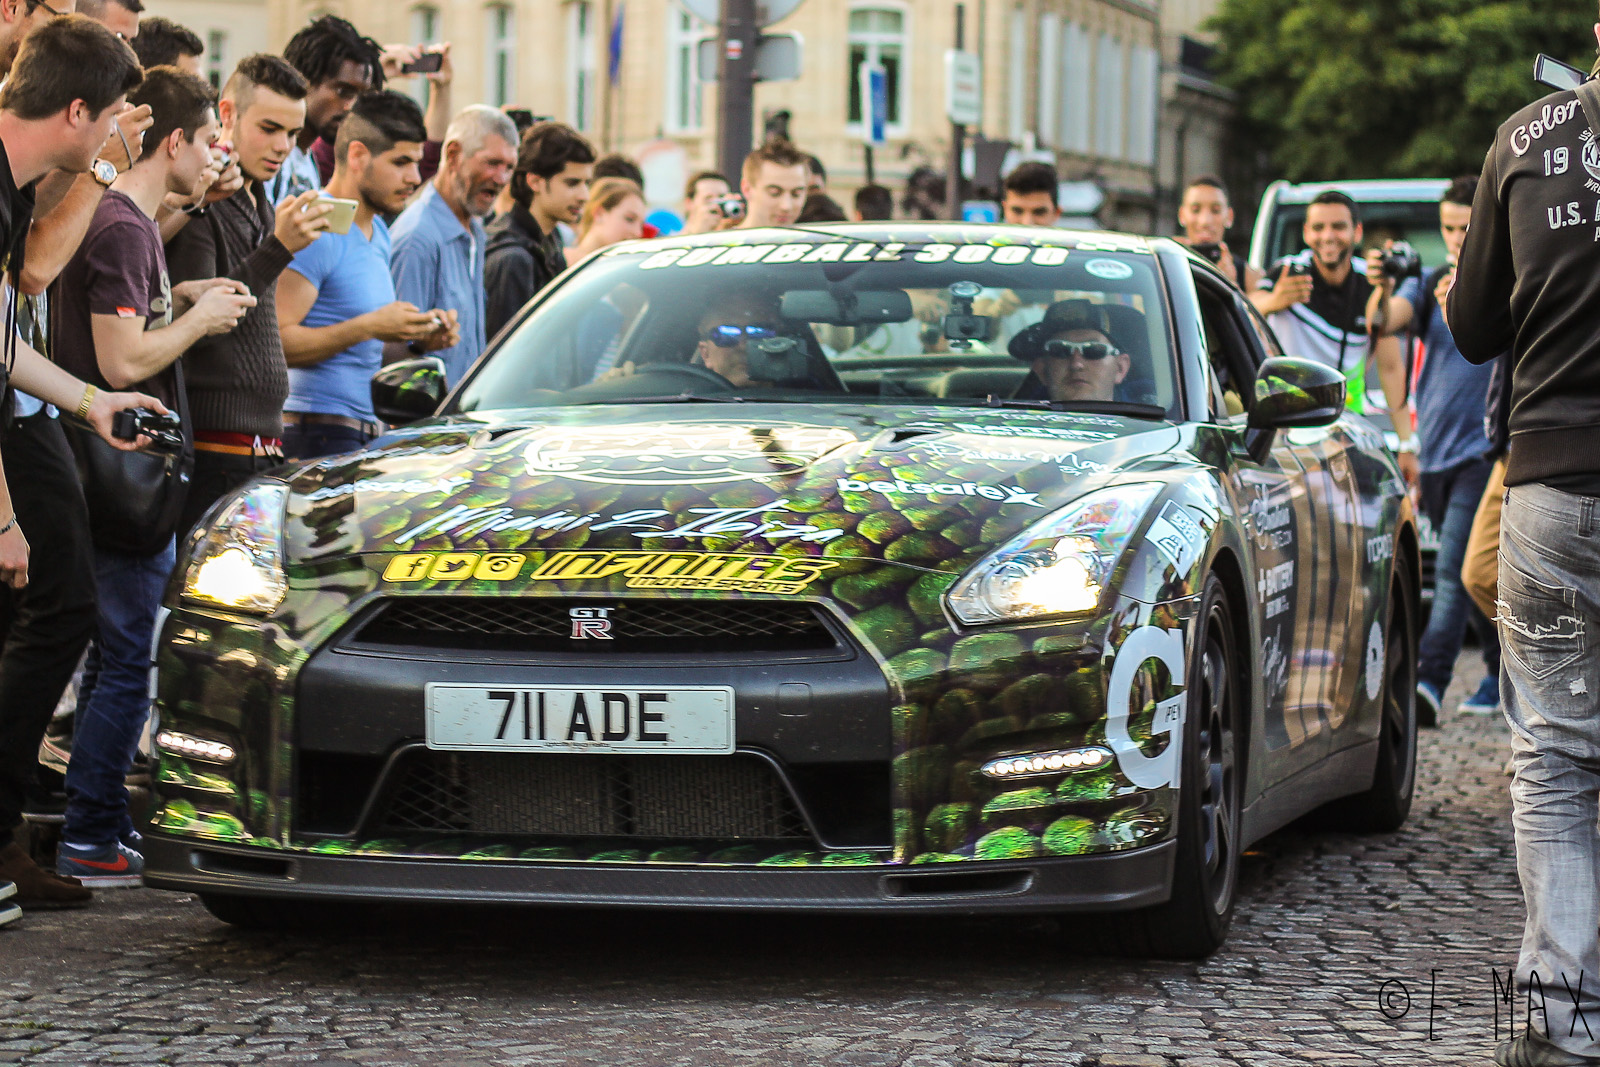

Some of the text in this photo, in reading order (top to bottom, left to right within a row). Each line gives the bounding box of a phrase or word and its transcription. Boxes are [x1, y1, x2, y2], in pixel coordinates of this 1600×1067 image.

[1543, 146, 1569, 177] 19
[1547, 201, 1587, 229] U.S.
[638, 242, 1069, 271] GUMBALL 3000
[631, 499, 845, 542] Ibiza
[570, 618, 614, 640] R
[486, 691, 669, 742] 711 ADE
